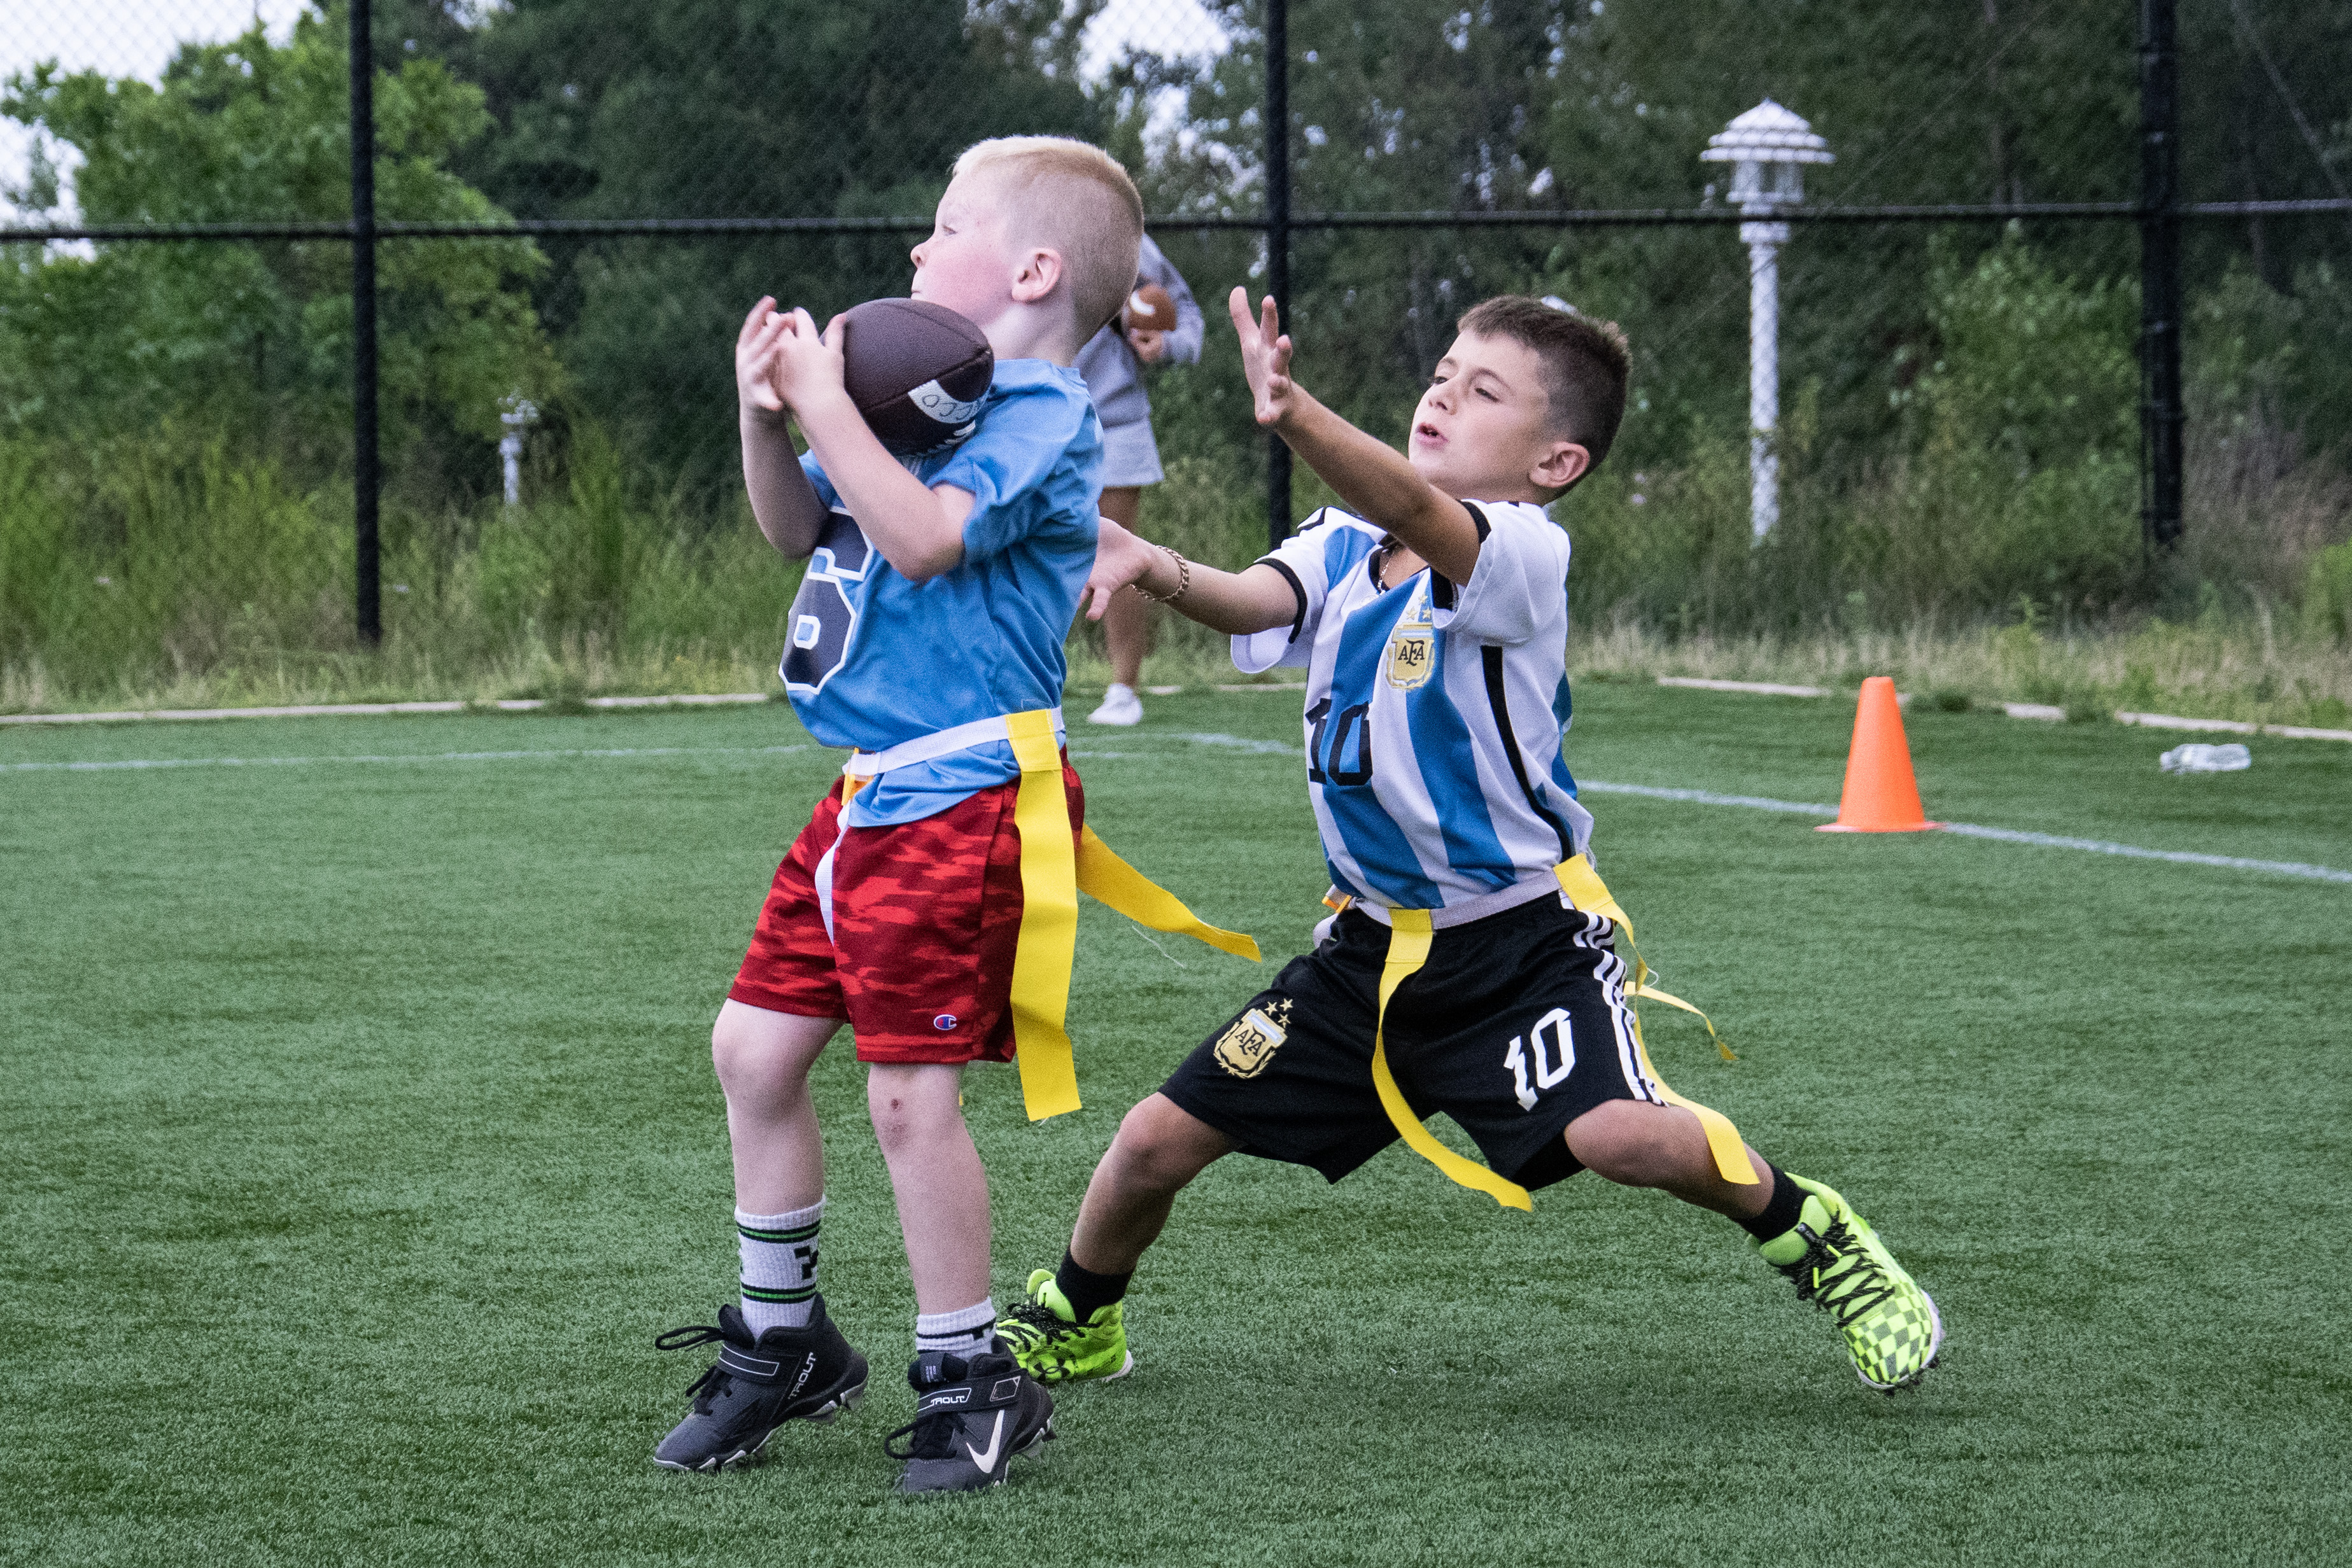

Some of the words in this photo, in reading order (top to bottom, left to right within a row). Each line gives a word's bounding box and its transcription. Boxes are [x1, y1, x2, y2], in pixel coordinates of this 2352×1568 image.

[1397, 638, 1425, 667] AFA
[1305, 697, 1373, 787] 10
[1234, 1025, 1267, 1057] AFA
[1503, 1007, 1576, 1112] 10
[787, 1352, 816, 1399] TROUT
[930, 1395, 966, 1406] TROUT
